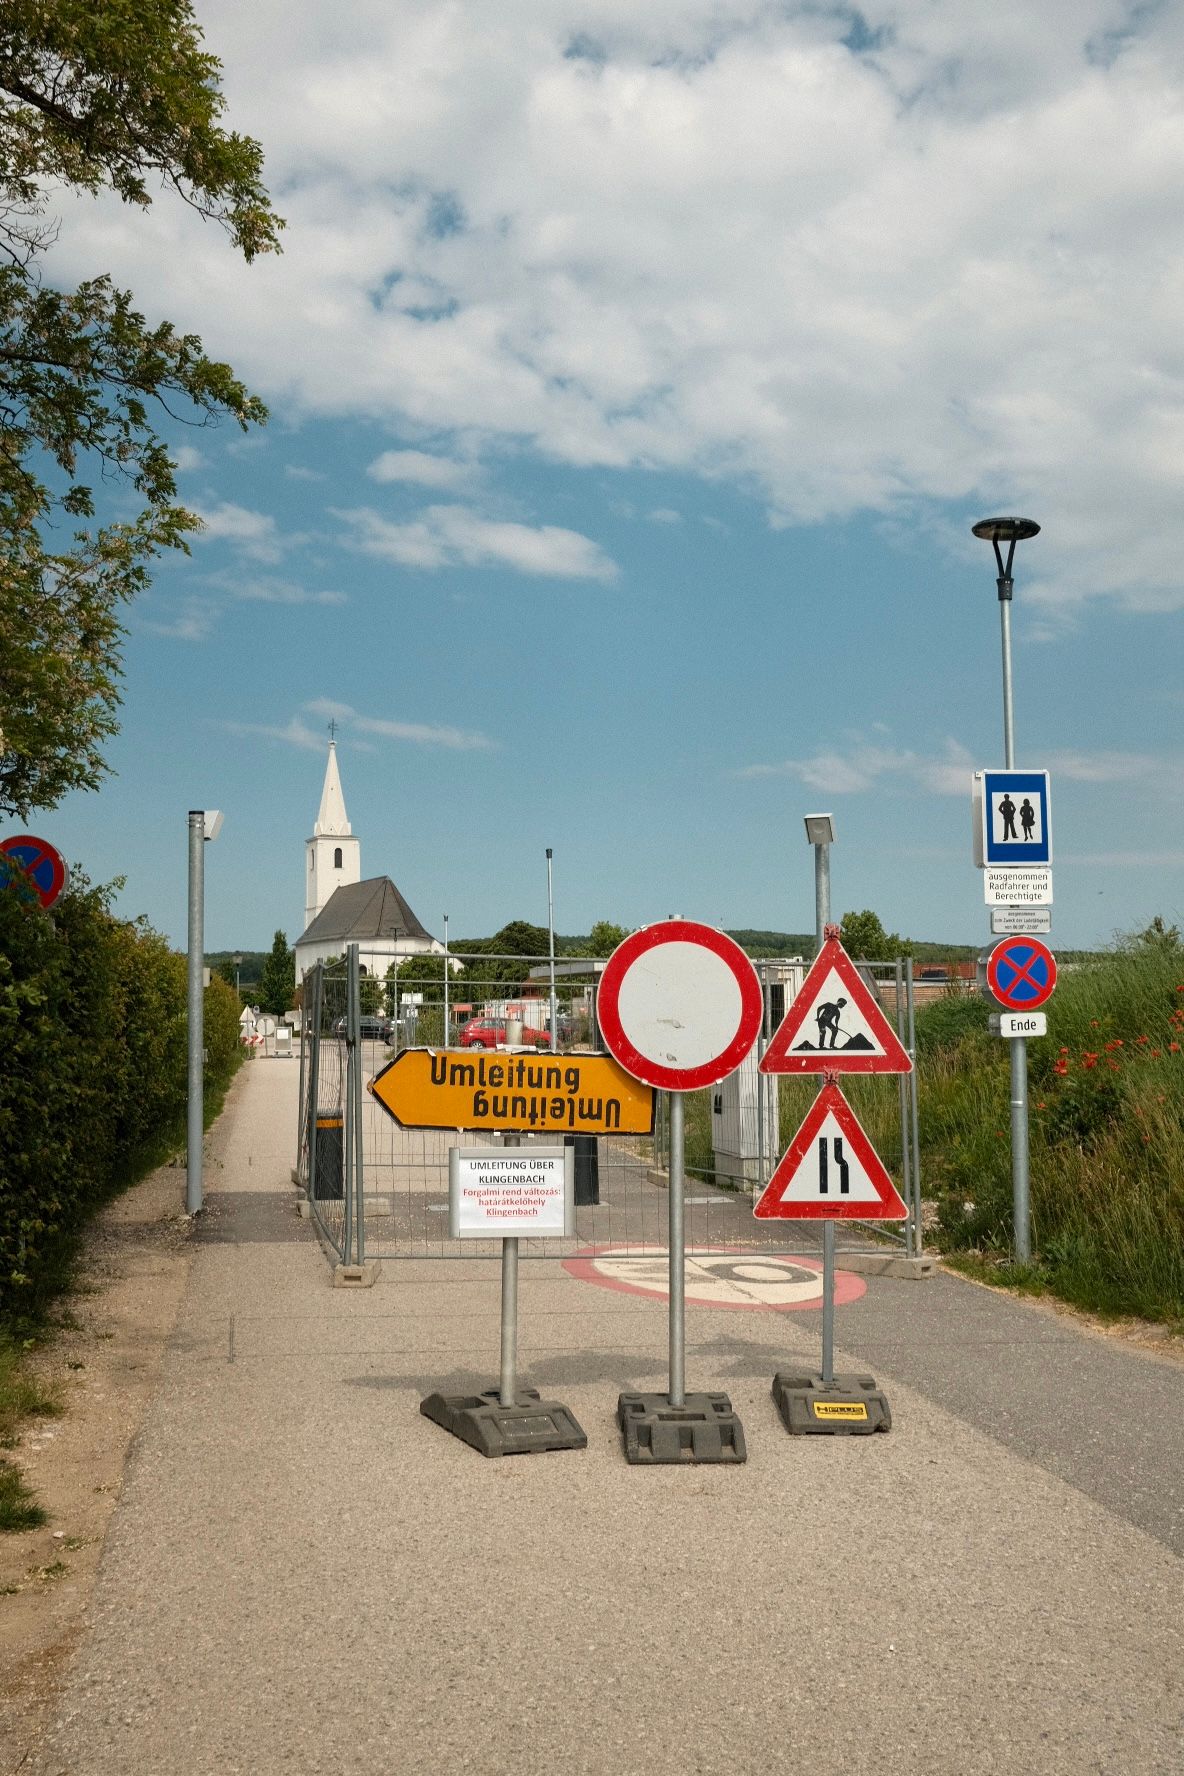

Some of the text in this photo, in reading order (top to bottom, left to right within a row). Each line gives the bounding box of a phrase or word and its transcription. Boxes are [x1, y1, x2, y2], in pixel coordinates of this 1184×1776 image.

[988, 873, 1048, 882] ausgenommen
[989, 882, 1048, 890] Radfahrer und
[995, 891, 1043, 901] Berechtigte
[1011, 1019, 1037, 1031] Ende
[430, 1056, 580, 1094] Umleitung
[473, 1090, 621, 1127] Umleitung
[470, 1159, 554, 1170] UMLEITUNG ÜBER
[479, 1175, 545, 1184] KLINGENBACH
[463, 1187, 561, 1197] Forgalmi rend változás:
[486, 1208, 538, 1217] Klingenbach
